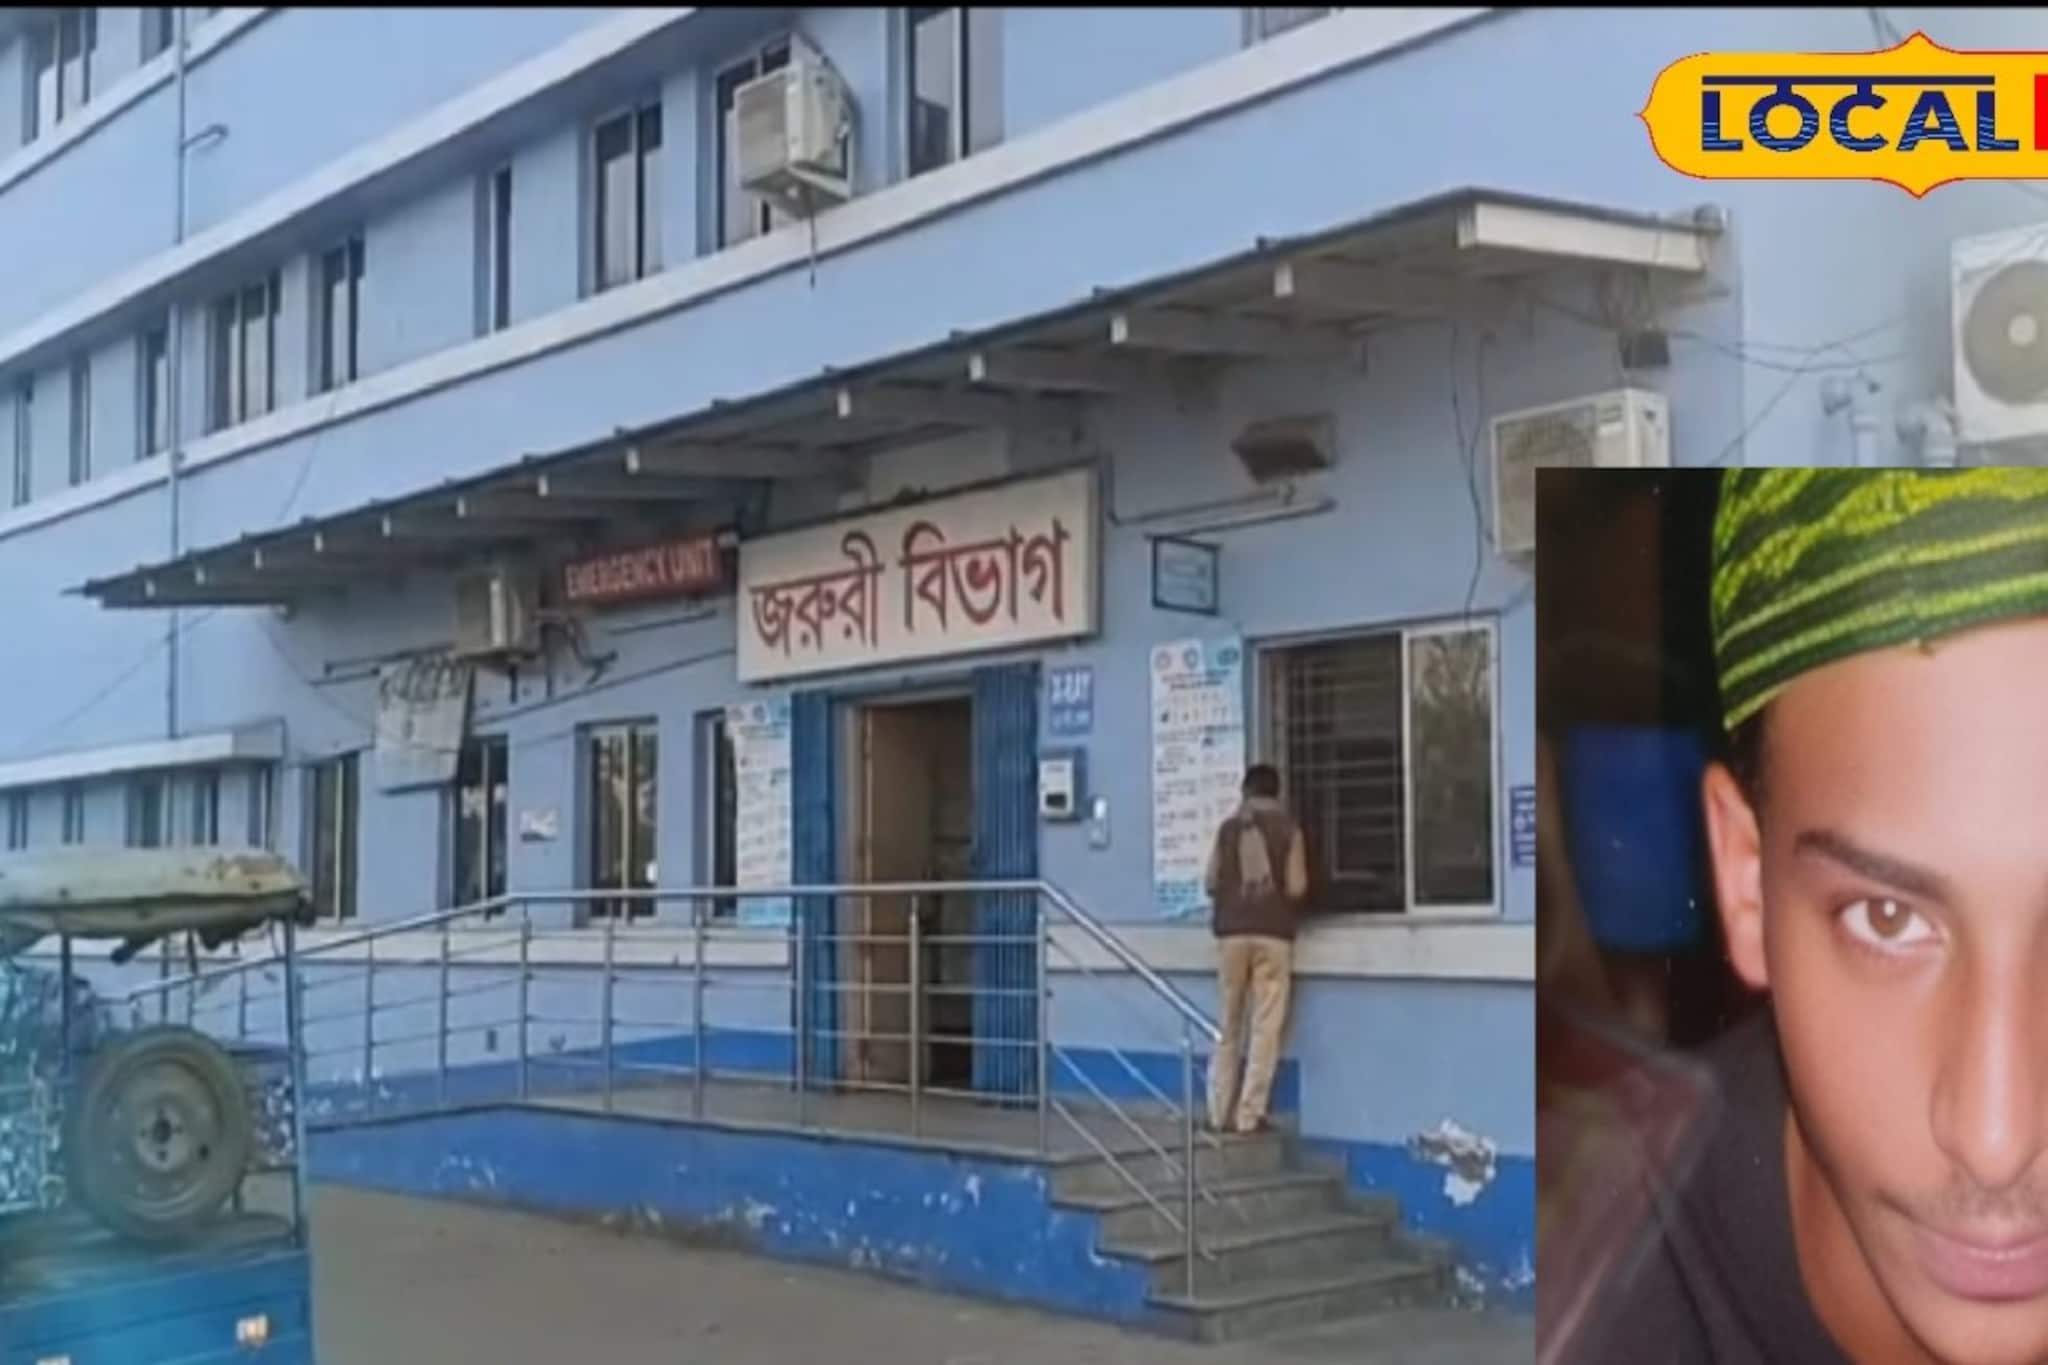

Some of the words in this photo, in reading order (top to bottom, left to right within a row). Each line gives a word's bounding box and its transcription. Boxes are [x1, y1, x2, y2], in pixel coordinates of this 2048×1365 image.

[565, 546, 668, 598] EMERGENCY
[669, 537, 714, 583] UNIT
[749, 530, 885, 656] জরুরী
[900, 519, 1070, 632] বিভাগ
